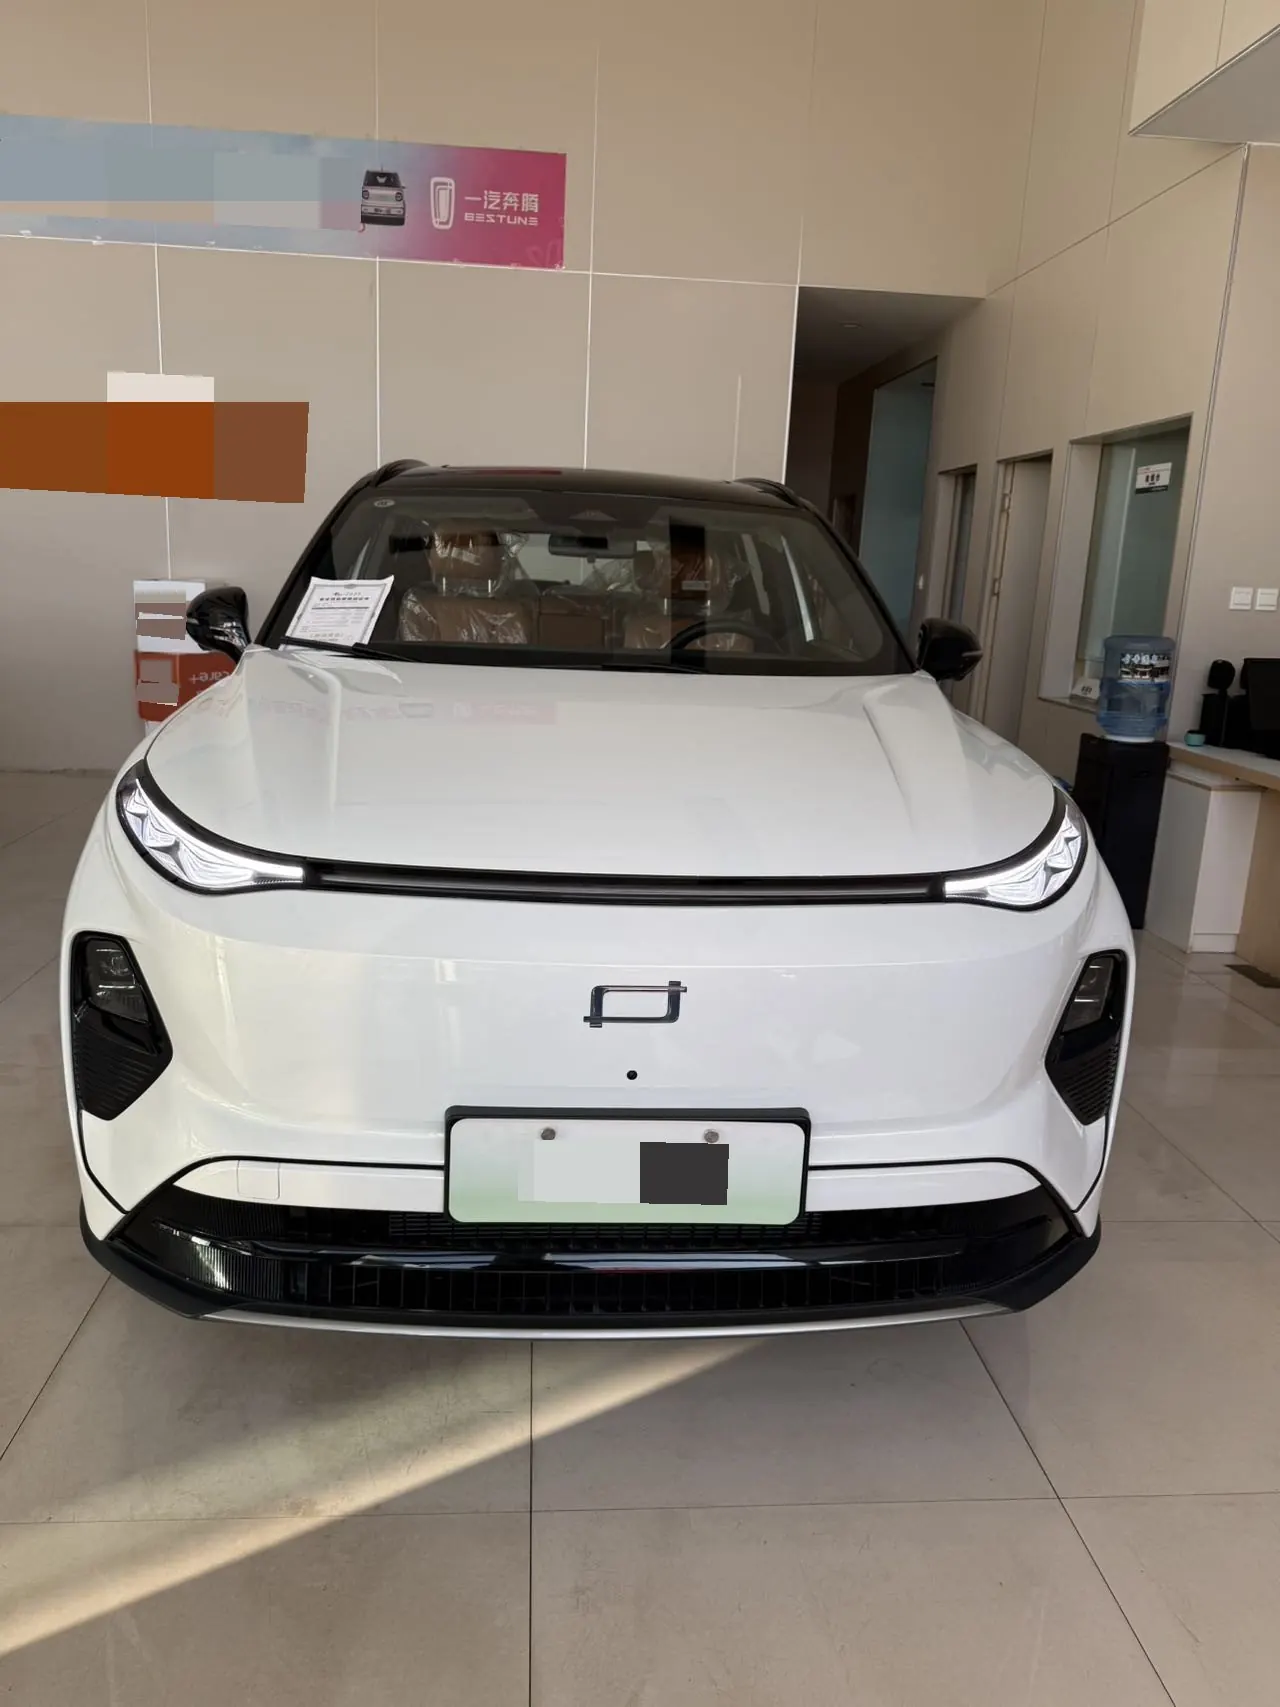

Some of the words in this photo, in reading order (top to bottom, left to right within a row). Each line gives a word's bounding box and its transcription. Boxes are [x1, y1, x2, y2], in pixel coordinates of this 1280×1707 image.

[464, 190, 539, 213] 一汽奔腾
[464, 212, 539, 226] BESTUNE
